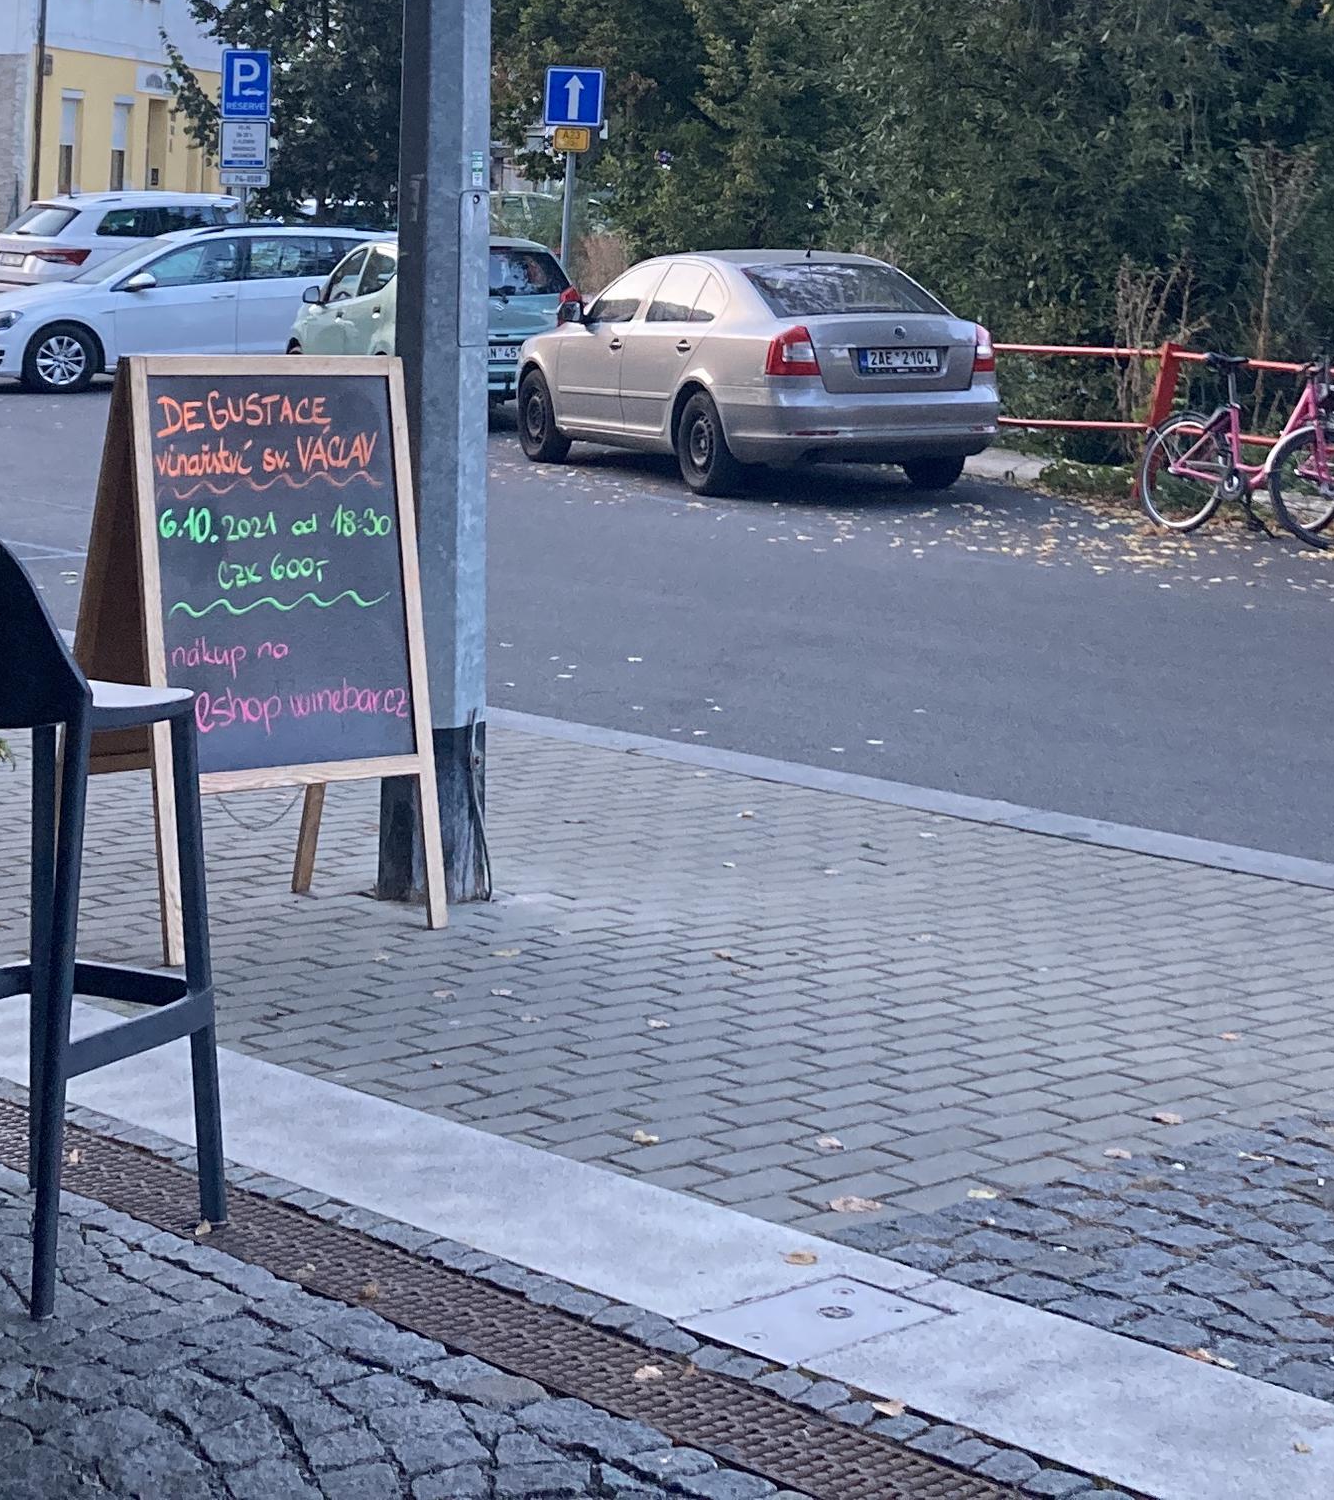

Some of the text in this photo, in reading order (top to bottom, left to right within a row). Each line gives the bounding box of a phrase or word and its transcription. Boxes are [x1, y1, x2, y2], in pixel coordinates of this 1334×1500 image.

[232, 58, 260, 96] P
[870, 351, 931, 365] 2AE 2104
[156, 390, 331, 438] DEGUSTACE
[261, 447, 290, 472] sv.
[296, 425, 378, 472] VÁCLAV
[291, 513, 318, 537] od
[330, 504, 392, 537] 18:30
[217, 559, 262, 590] CZK
[171, 636, 289, 680] nákup na
